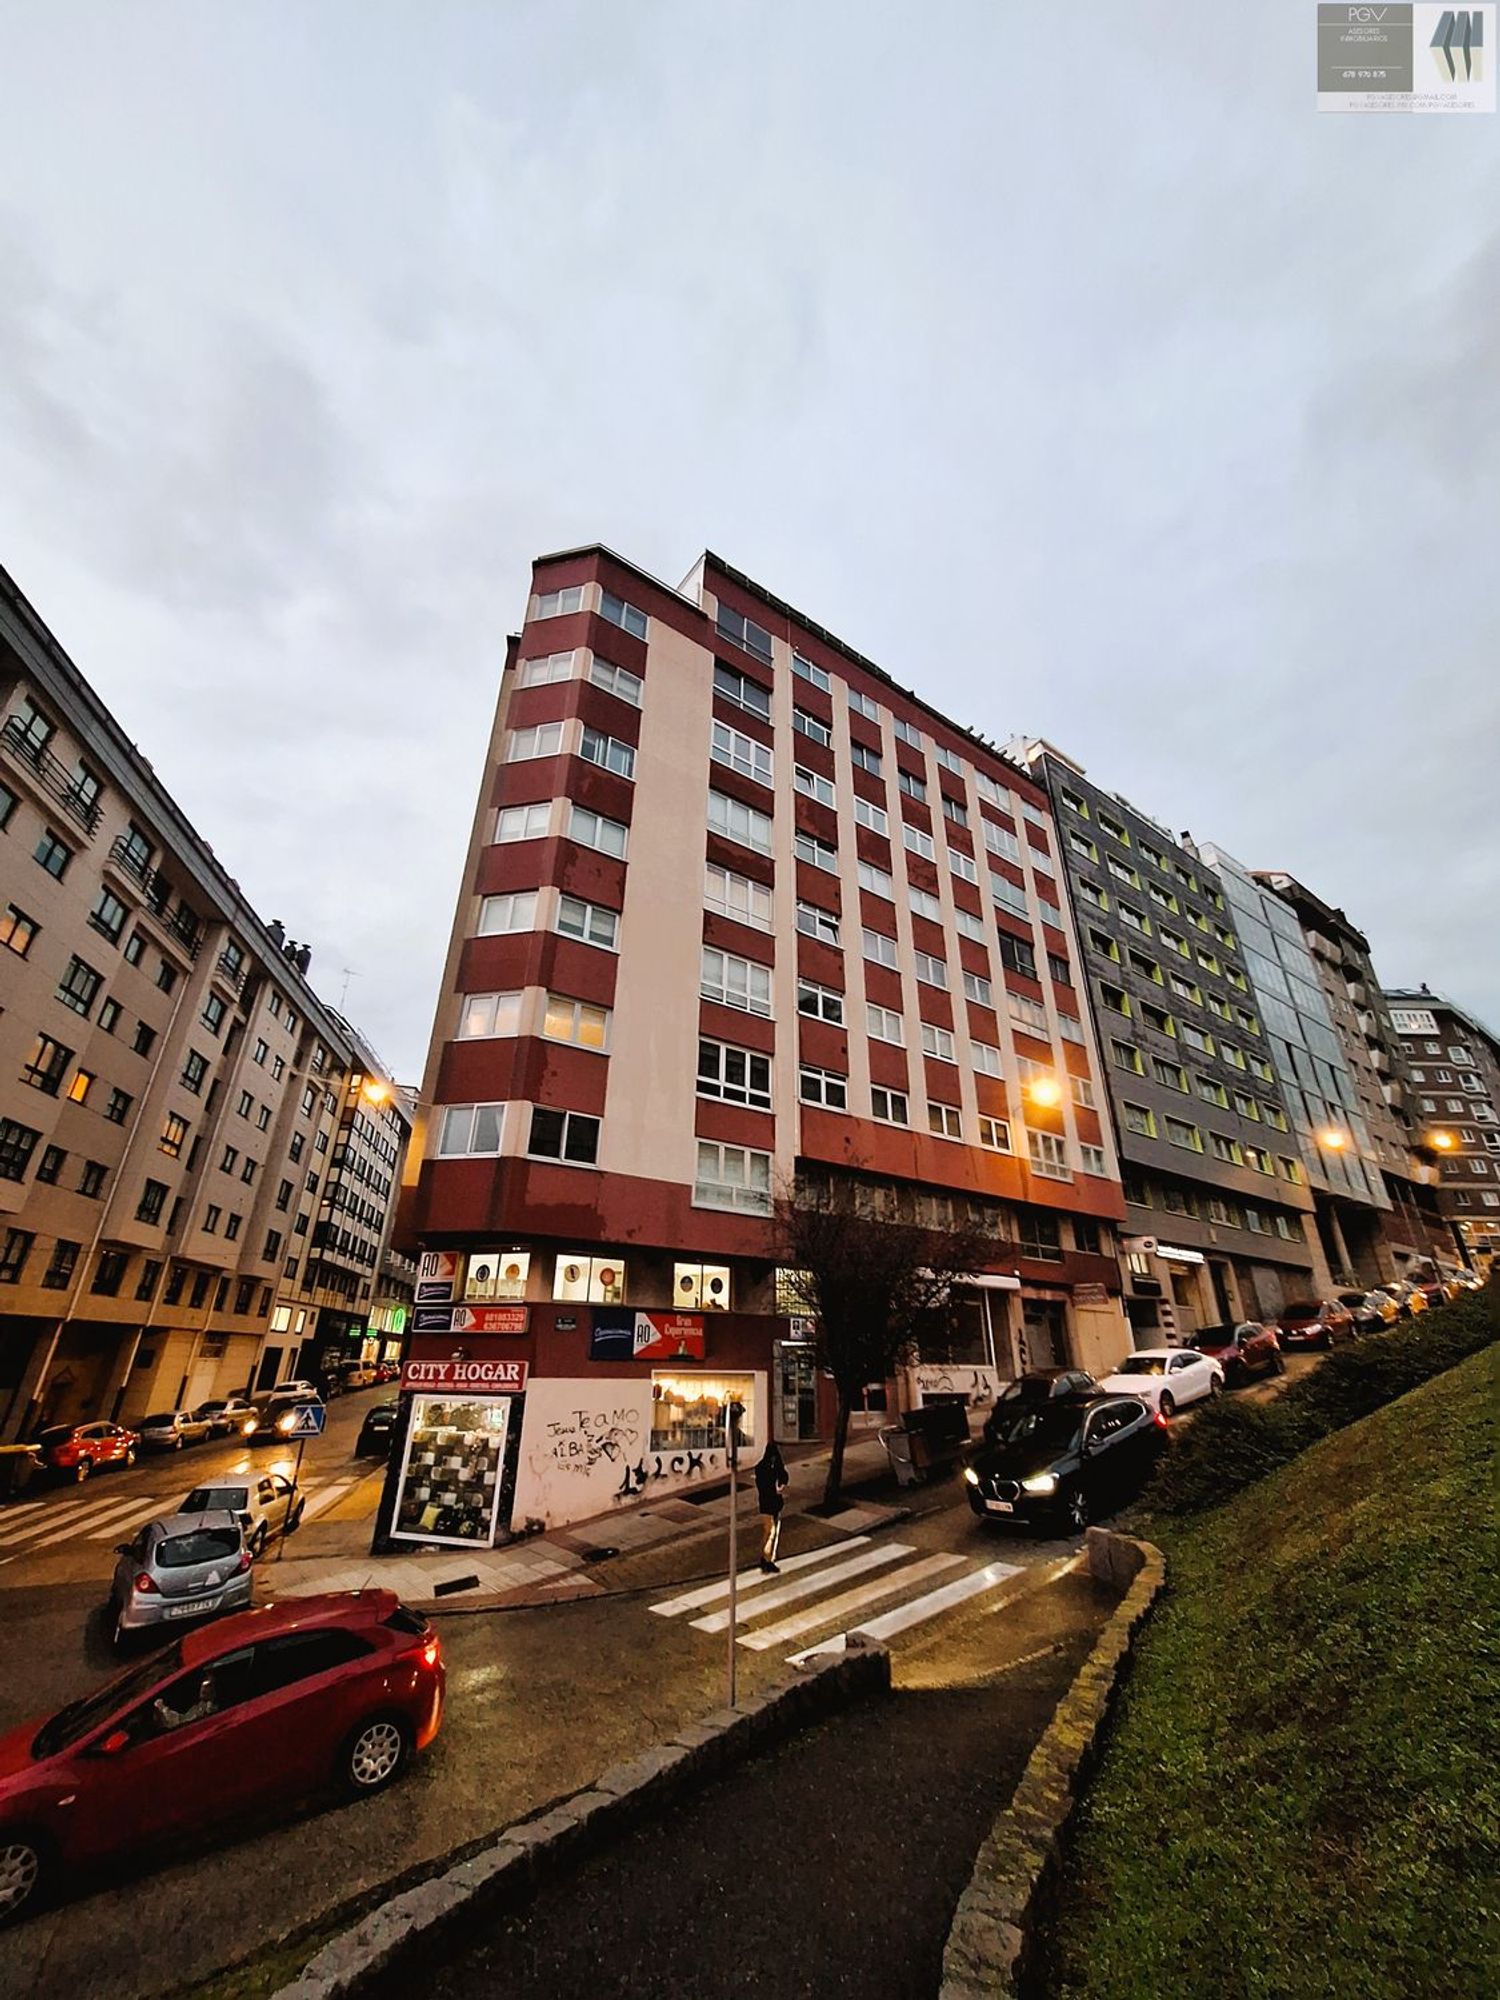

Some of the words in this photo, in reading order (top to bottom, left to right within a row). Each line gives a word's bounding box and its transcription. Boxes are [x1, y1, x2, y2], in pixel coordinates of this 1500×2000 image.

[421, 1253, 440, 1277] AO
[453, 1309, 467, 1328] AO
[636, 1324, 651, 1344] AO
[407, 1363, 450, 1380] CITY
[452, 1363, 520, 1380] HOGAR
